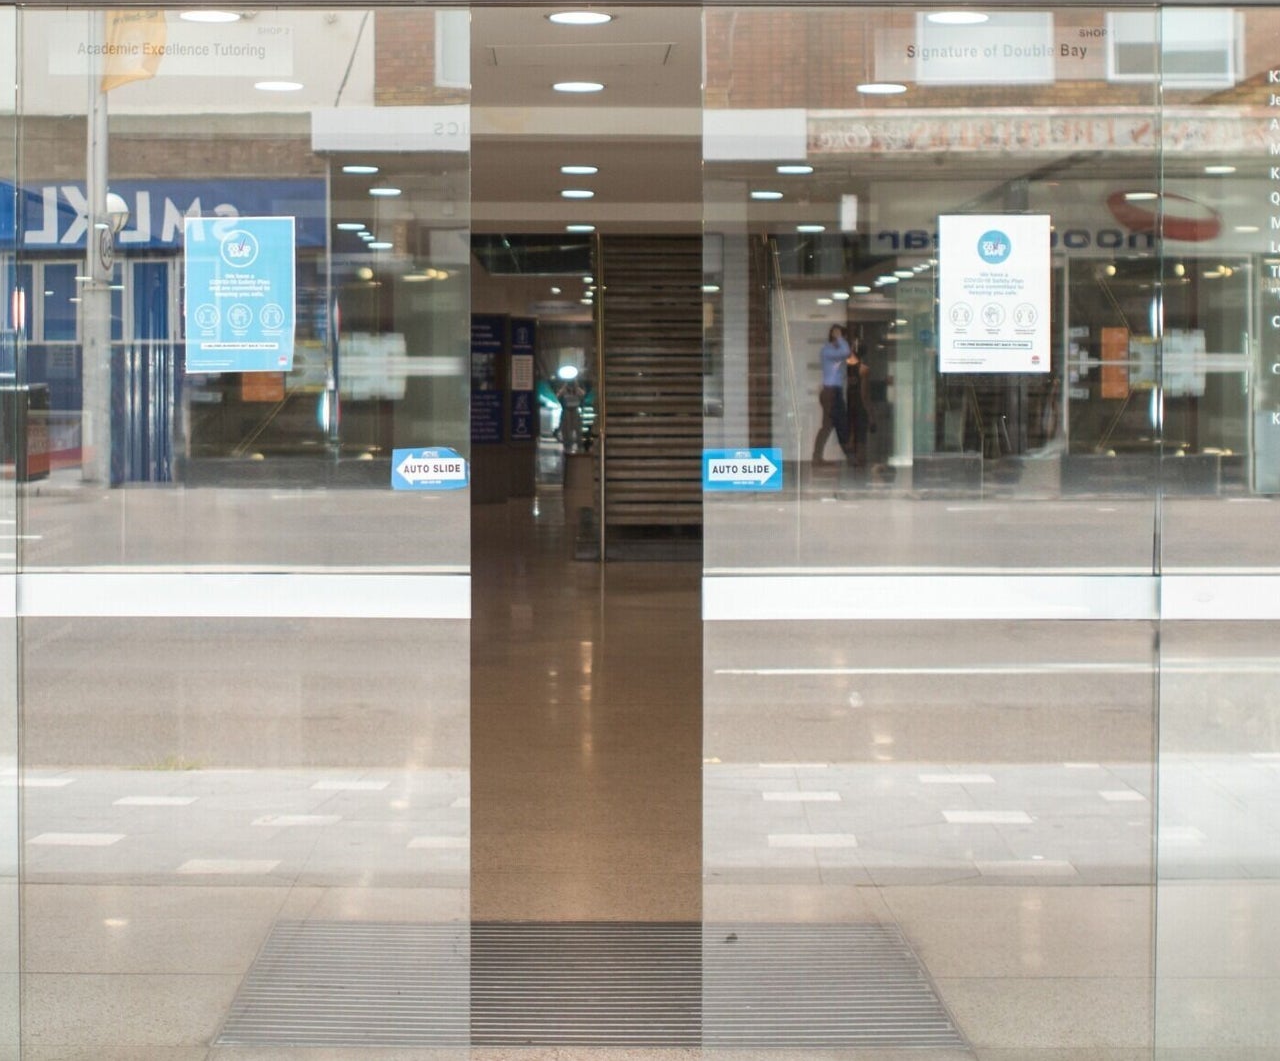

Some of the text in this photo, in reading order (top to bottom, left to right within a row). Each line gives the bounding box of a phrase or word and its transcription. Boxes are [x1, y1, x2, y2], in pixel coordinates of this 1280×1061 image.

[77, 42, 266, 59] Academic Excellence Tutoring
[907, 44, 1087, 60] Signature of Double Bay
[404, 464, 461, 473] AUTO SLIDE
[713, 465, 769, 474] AUTO SLIDE
